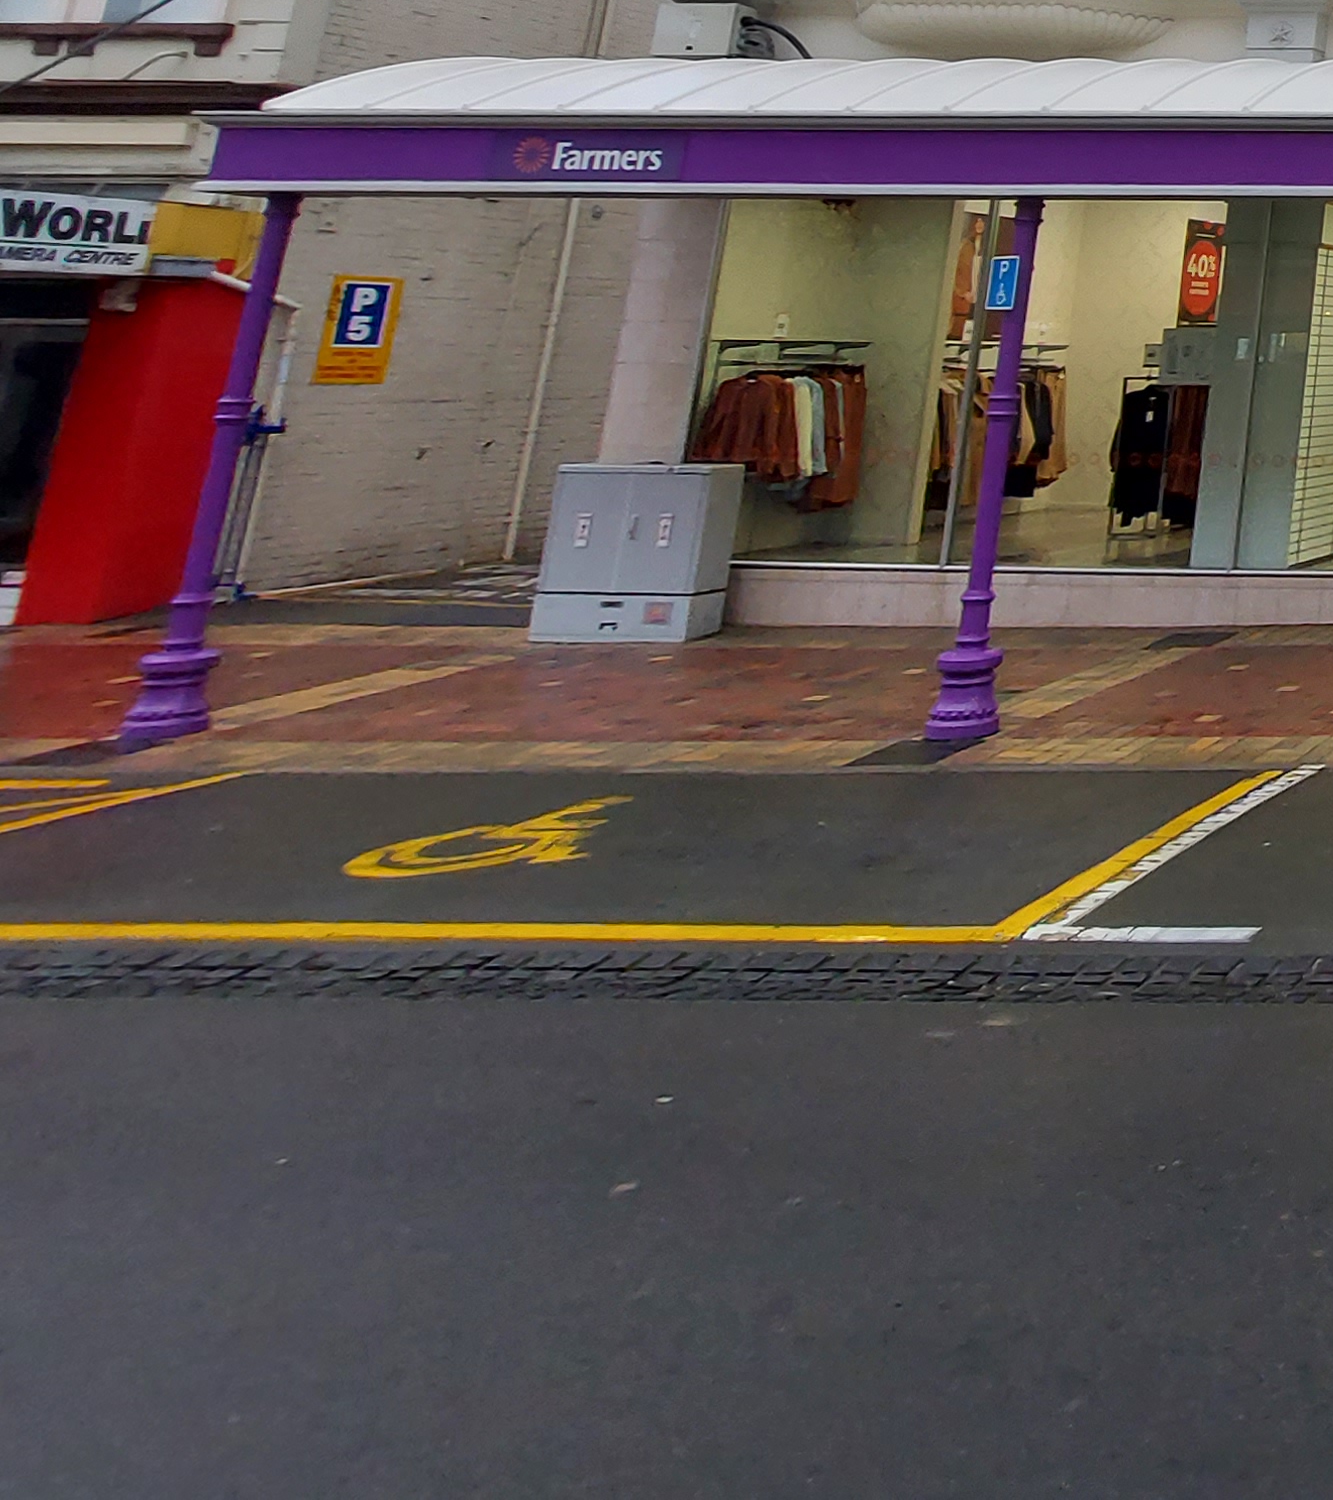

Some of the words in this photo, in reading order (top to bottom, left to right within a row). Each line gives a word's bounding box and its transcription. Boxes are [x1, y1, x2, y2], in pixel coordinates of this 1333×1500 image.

[551, 142, 663, 171] Farmers
[64, 250, 140, 265] CENTRE
[999, 261, 1010, 279] P
[350, 287, 379, 312] P
[345, 315, 374, 341] 5
